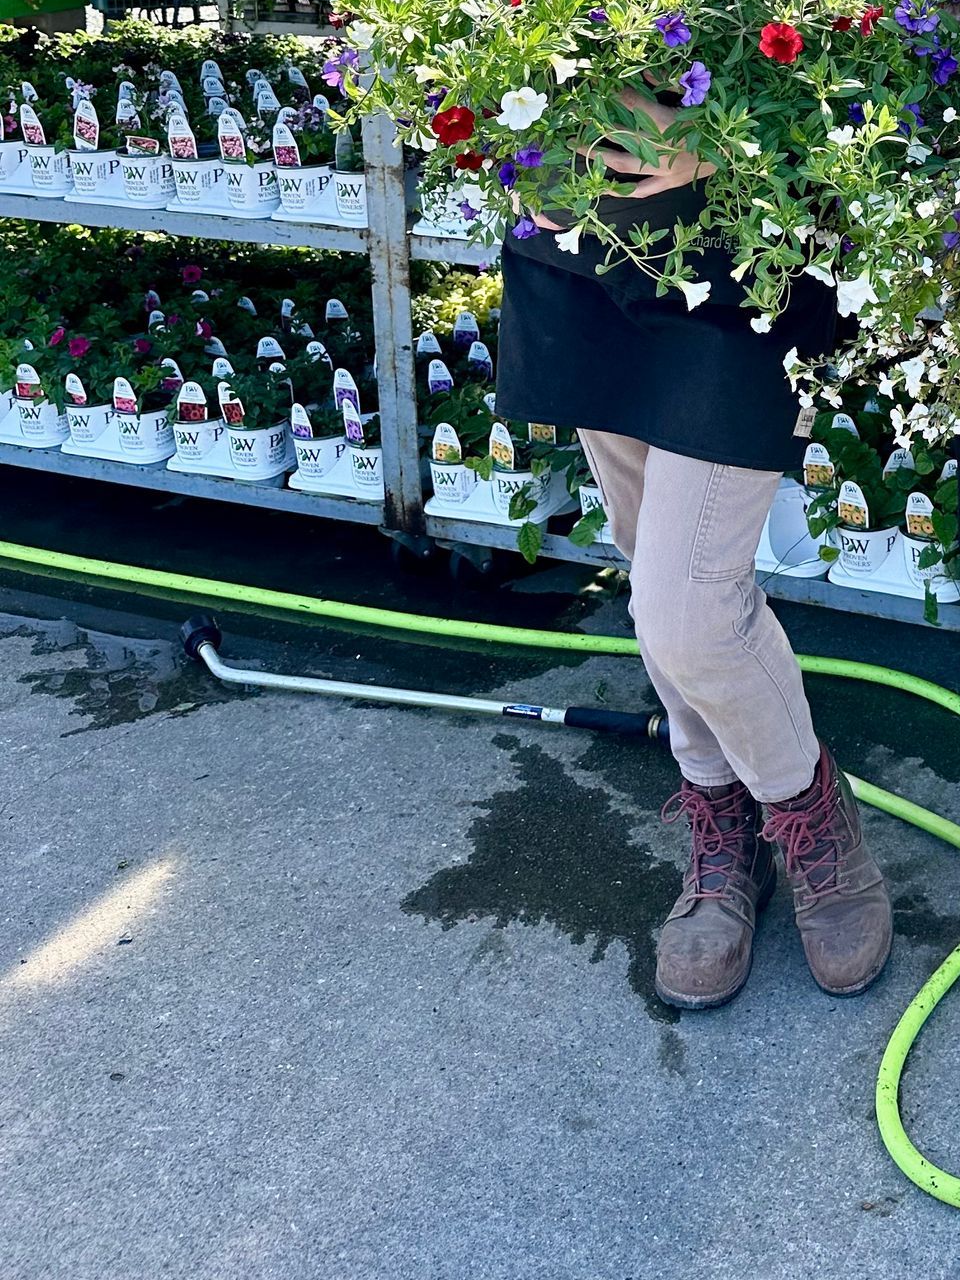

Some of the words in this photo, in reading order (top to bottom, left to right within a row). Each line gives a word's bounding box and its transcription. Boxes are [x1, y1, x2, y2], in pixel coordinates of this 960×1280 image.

[336, 182, 361, 198] PW
[690, 226, 731, 250] chard's
[352, 454, 378, 470] PW
[433, 470, 458, 485] PW
[841, 535, 871, 554] PW
